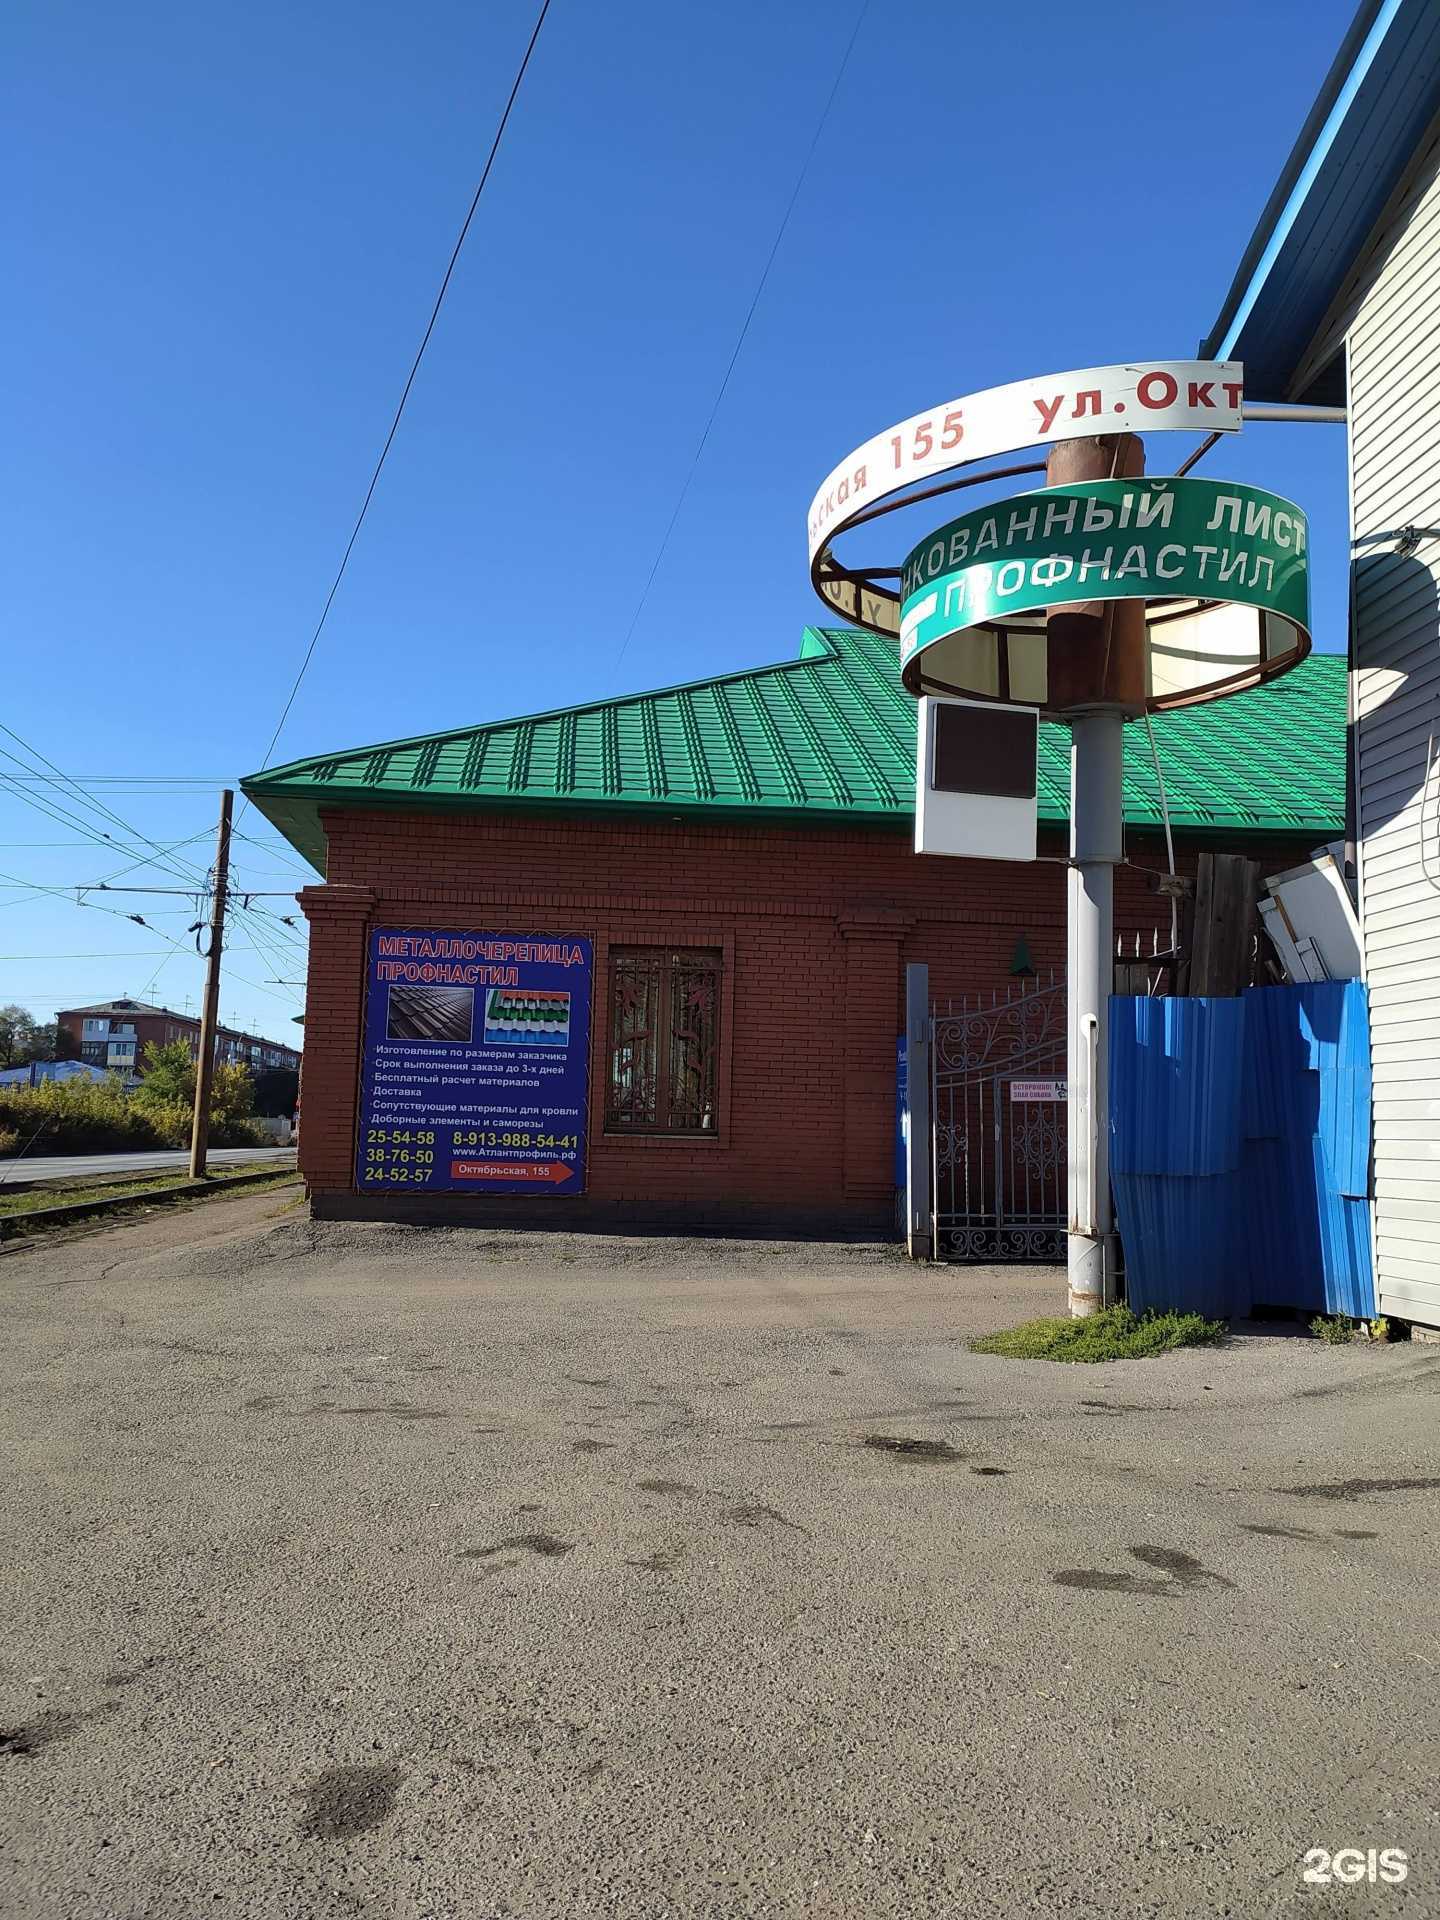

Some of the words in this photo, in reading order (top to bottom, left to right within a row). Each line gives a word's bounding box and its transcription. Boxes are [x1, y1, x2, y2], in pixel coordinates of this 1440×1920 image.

[891, 410, 964, 470] 155
[1206, 495, 1307, 556] ЛИСТ
[943, 544, 1275, 618] ПРОФНАСТИЛ
[378, 936, 584, 967] МЕТАЛЛОЧЕРЕПИЦА
[376, 961, 519, 986] ПРОФНАСТИЛ
[376, 1044, 447, 1057] Изготовление
[450, 1048, 462, 1057] по
[465, 1050, 515, 1061] размерам
[518, 1052, 568, 1061] заказчика
[375, 1059, 401, 1070] Срок
[404, 1061, 469, 1071] выполнения
[471, 1063, 504, 1073] заказа
[506, 1065, 519, 1074] до
[522, 1064, 537, 1073] 3-х
[539, 1065, 565, 1075] дней
[374, 1072, 439, 1084] Бесплатный
[442, 1076, 476, 1086] расчет
[479, 1078, 540, 1089] материалов
[373, 1086, 422, 1098] Доставка
[373, 1100, 457, 1113] Сопутствующие
[460, 1104, 517, 1115] материалы
[520, 1106, 539, 1115] для
[542, 1107, 579, 1118] кровли
[371, 1113, 427, 1125] Доборные
[429, 1116, 480, 1127] элементы
[483, 1119, 490, 1127] и
[492, 1120, 544, 1129] саморезы
[367, 1130, 435, 1145] 25-54-58
[453, 1131, 578, 1149] 8-913-988-54-41
[366, 1148, 434, 1164] 38-76-50
[452, 1147, 577, 1160] www.Атлантпрофиль.рф
[364, 1167, 433, 1183] 24-52-57
[459, 1164, 529, 1177] Октябрьская,
[532, 1166, 550, 1176] 155
